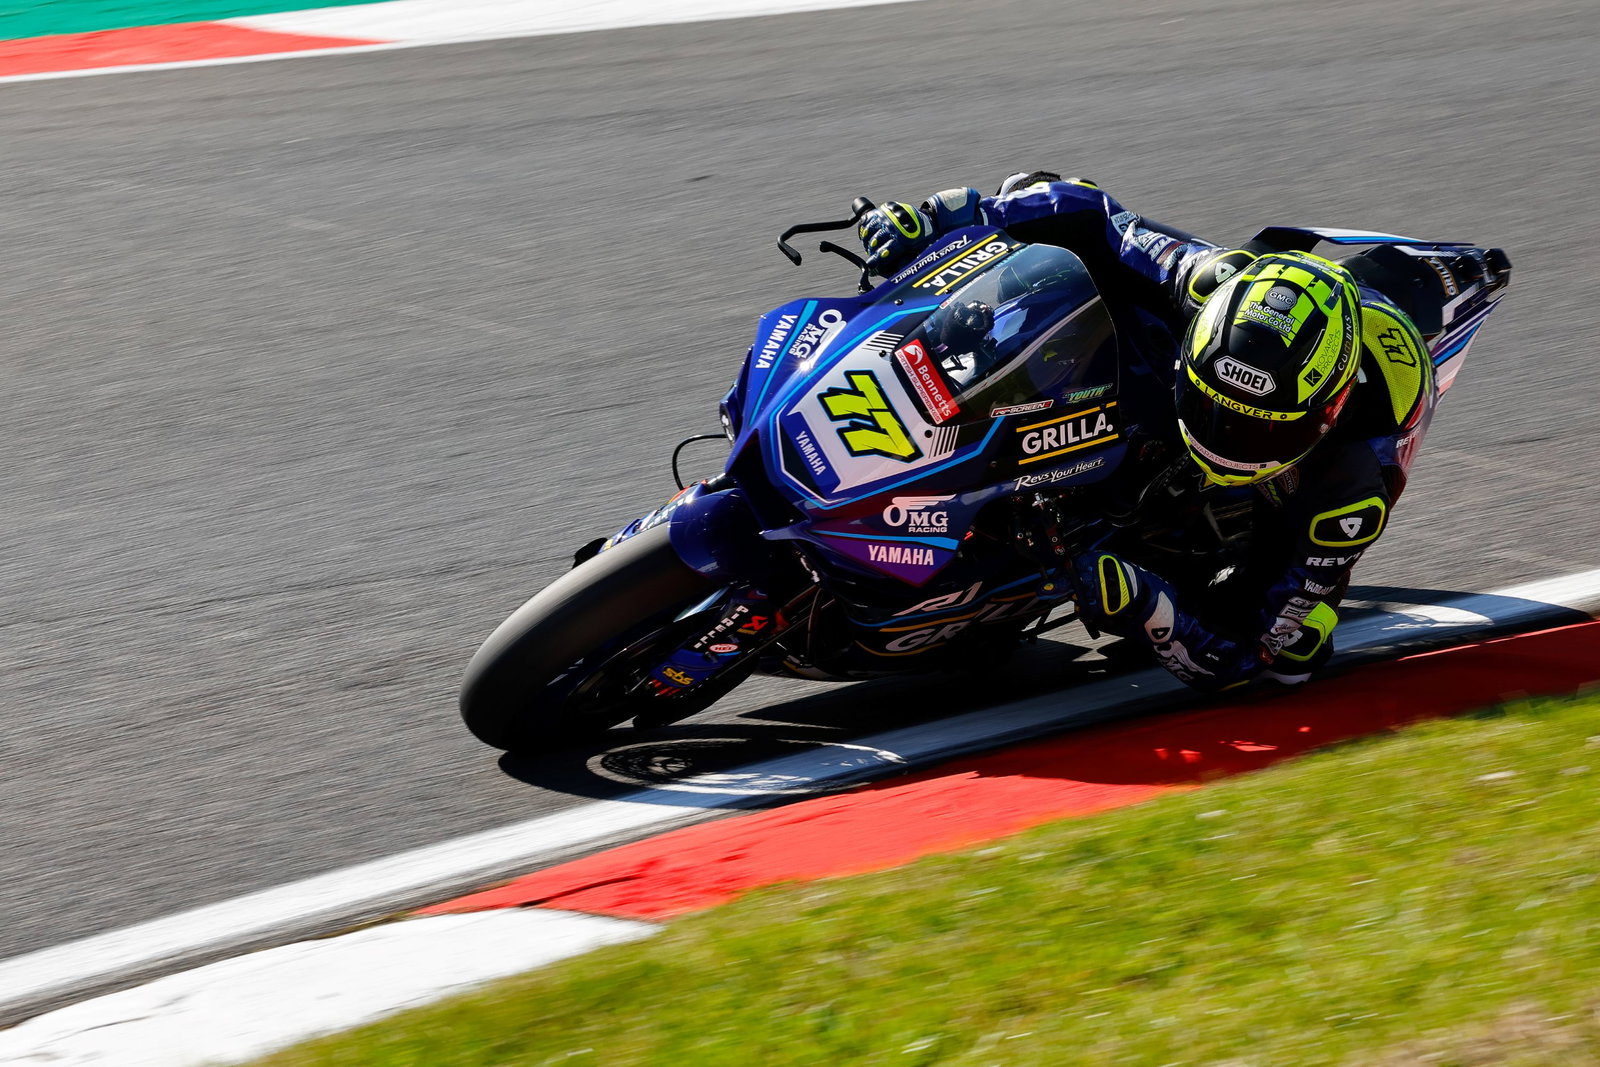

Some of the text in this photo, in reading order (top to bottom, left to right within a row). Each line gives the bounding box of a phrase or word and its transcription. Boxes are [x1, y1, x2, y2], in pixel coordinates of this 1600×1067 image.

[893, 234, 972, 284] Revs Your Heart
[1249, 301, 1294, 324] The General
[1269, 291, 1293, 305] GMC
[1245, 309, 1268, 322] Motor
[1268, 316, 1279, 326] Co
[1279, 319, 1293, 333] Ltd
[755, 314, 799, 369] YAMAHA
[1315, 333, 1334, 369] KOVARA
[1321, 328, 1340, 374] PROJECTS
[917, 364, 952, 417] Bennetts
[1221, 361, 1268, 392] SHOEI
[817, 369, 925, 464] 77
[1204, 386, 1274, 420] LANGVER
[795, 431, 827, 476] YAMAHA
[1215, 457, 1259, 470] PROJECTS
[1013, 457, 1105, 491] Revs Your Heart
[908, 525, 948, 533] RACING
[868, 544, 934, 566] YAMAHA
[693, 605, 749, 649] PIRELLI
[662, 667, 694, 685] sbs
